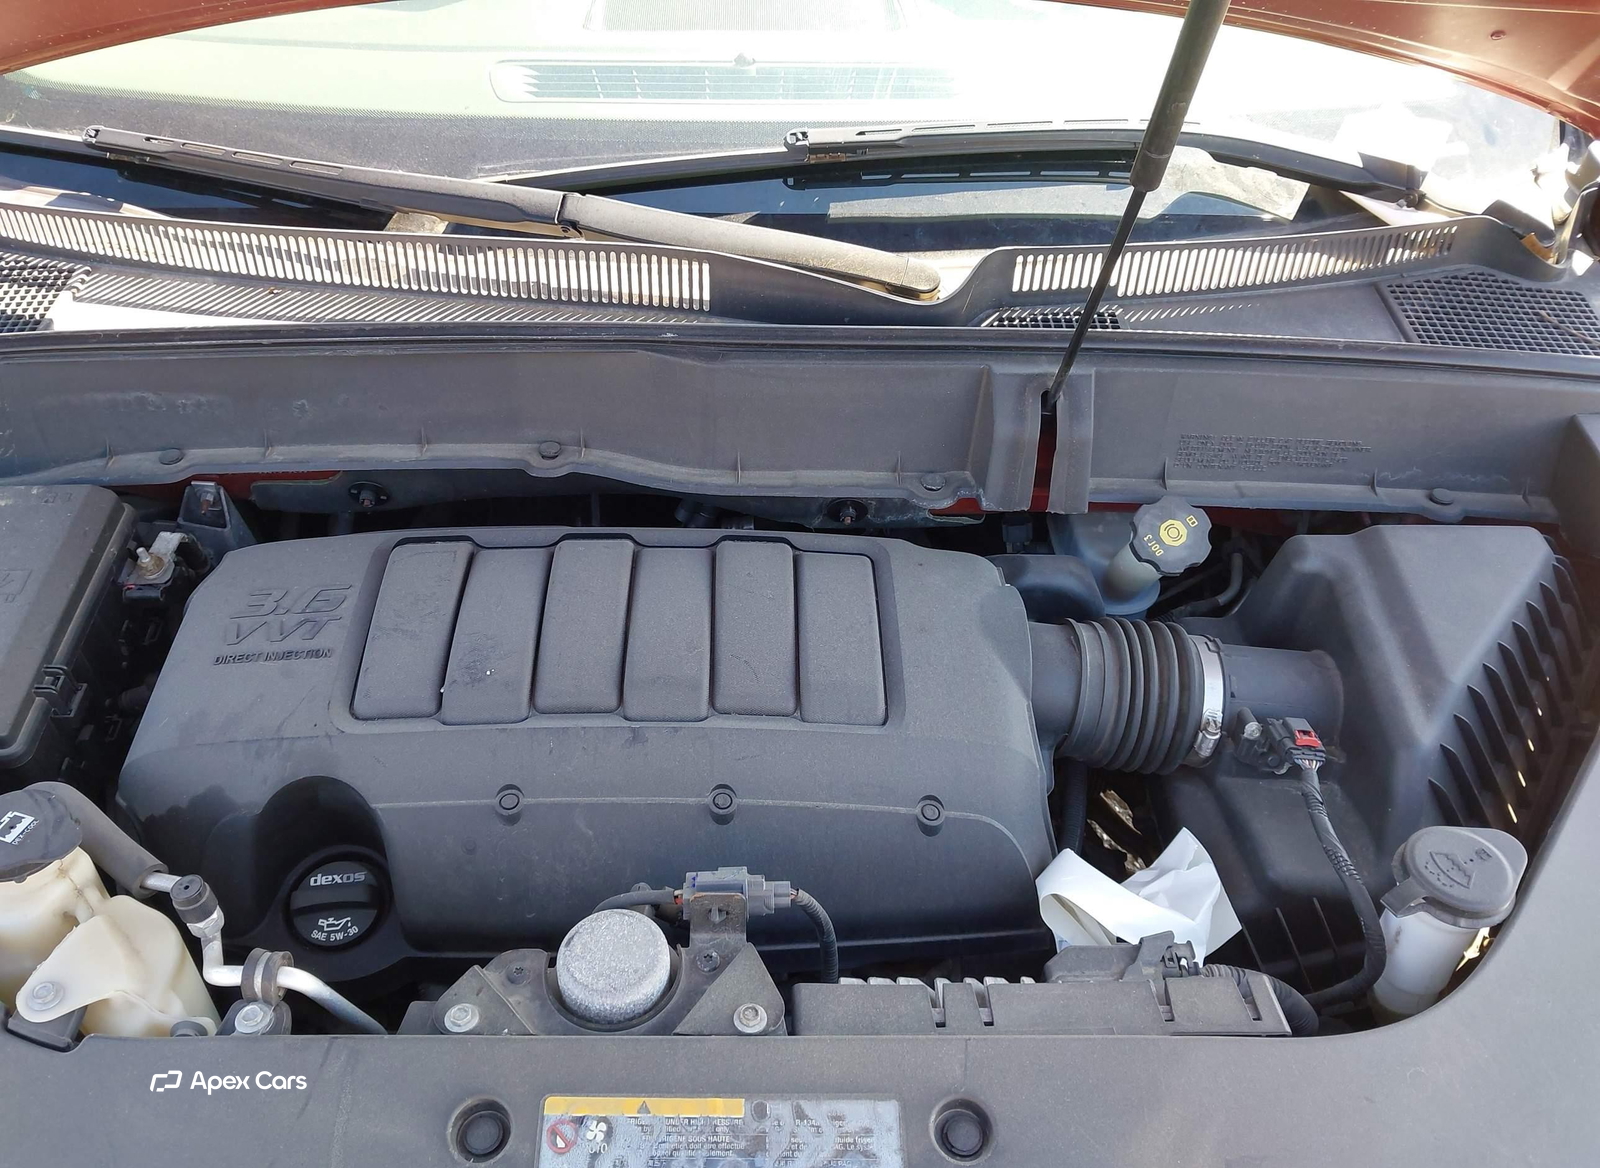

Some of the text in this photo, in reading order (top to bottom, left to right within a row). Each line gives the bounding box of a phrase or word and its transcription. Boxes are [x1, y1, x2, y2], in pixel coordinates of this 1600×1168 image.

[230, 585, 352, 619] 3.6
[224, 616, 342, 646] VVT
[213, 648, 333, 665] DIRECT INJECTION
[310, 871, 367, 886] dexos
[310, 925, 359, 941] SAE 5W-30
